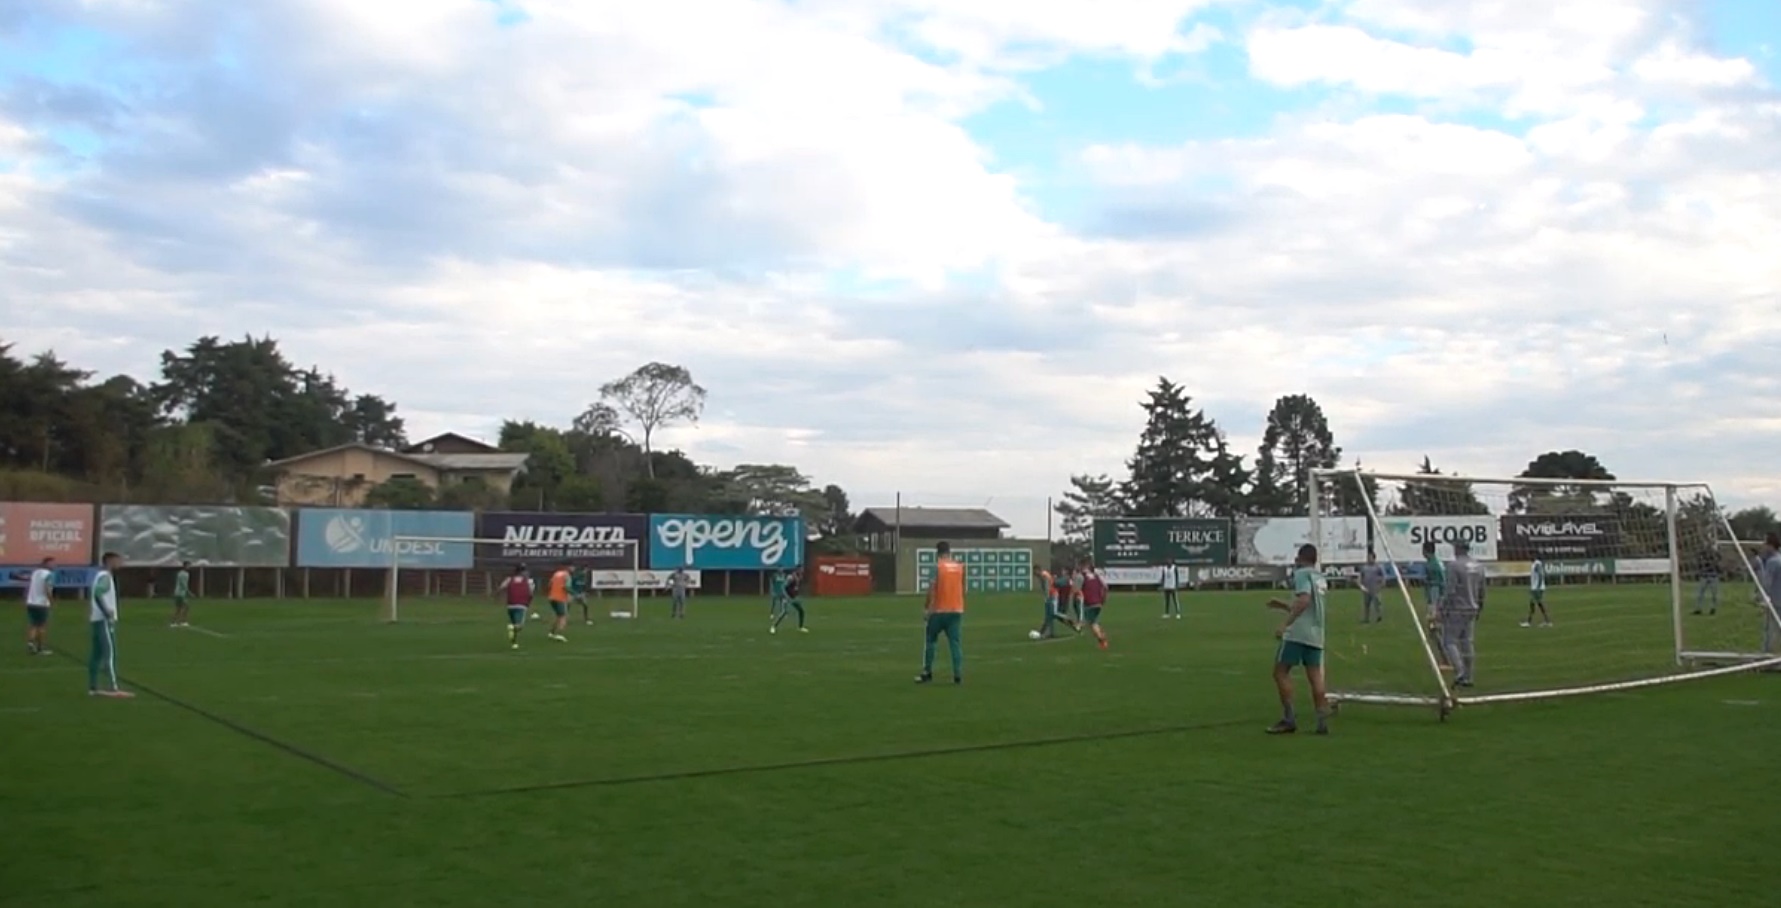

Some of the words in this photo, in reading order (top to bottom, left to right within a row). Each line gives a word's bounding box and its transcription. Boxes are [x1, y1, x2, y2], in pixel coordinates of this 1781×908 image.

[30, 530, 82, 542] OFICIAL
[503, 525, 626, 548] NUTRATA
[1167, 530, 1224, 543] TERRACE
[1410, 525, 1487, 544] SICOOB
[657, 519, 787, 565] openz
[503, 549, 563, 557] SUPLEMENTOS
[1545, 561, 1589, 574] Unimed
